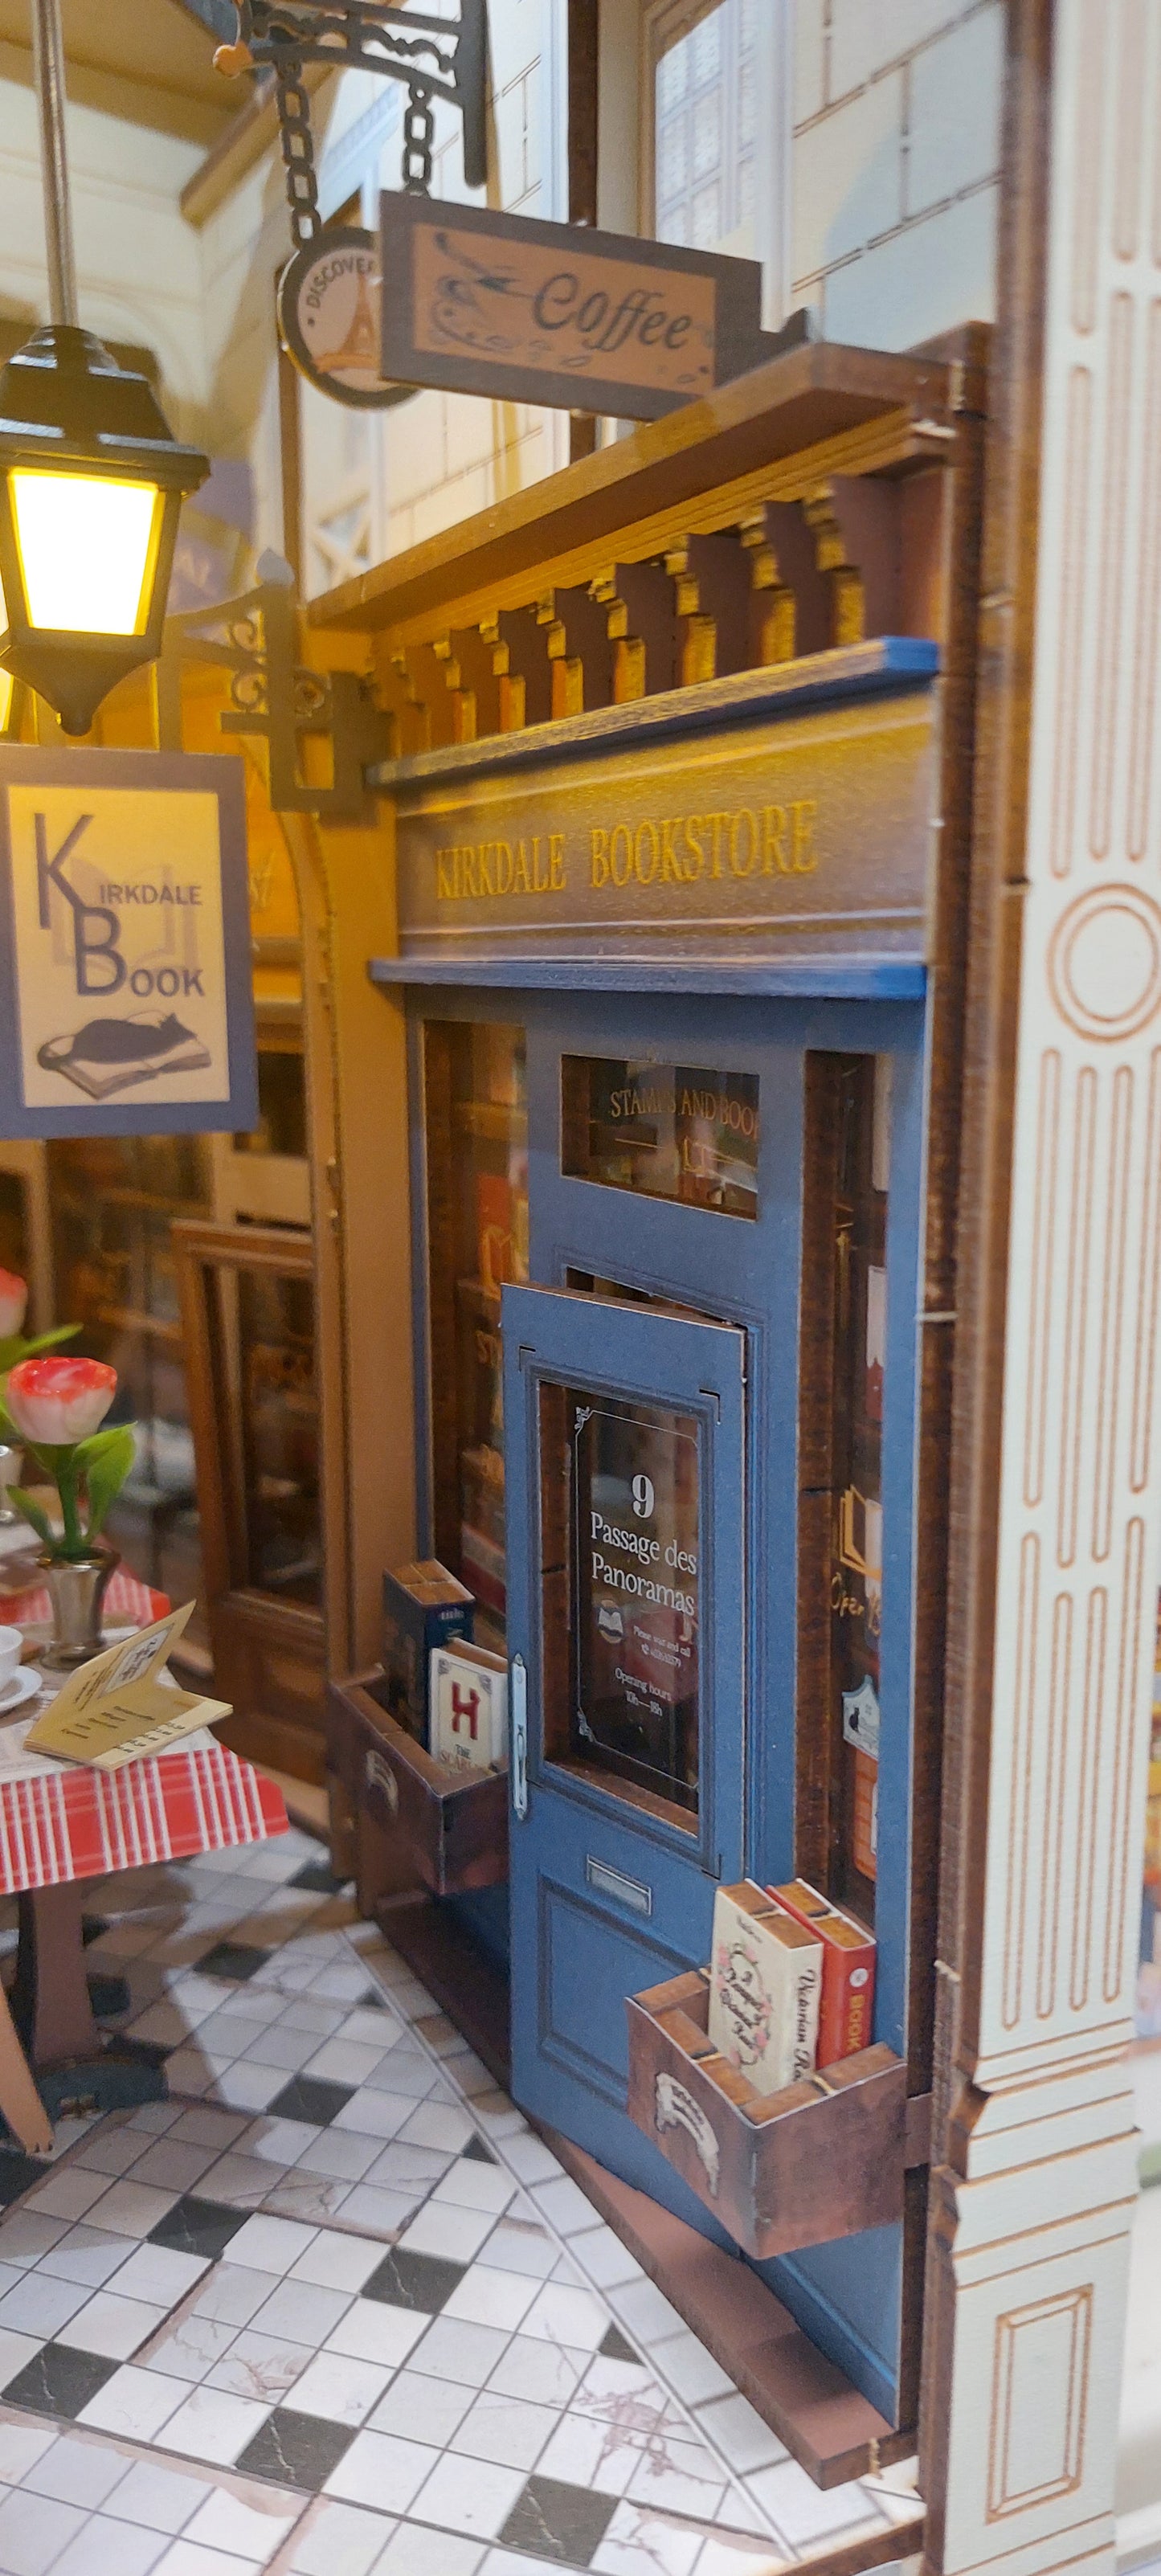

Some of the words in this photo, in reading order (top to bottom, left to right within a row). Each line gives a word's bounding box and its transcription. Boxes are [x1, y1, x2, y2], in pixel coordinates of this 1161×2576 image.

[306, 256, 374, 309] DISCOVE
[533, 272, 693, 352] Coffee
[436, 833, 567, 900] KIRKDALE
[589, 800, 819, 889] BOOKSTORE
[681, 1089, 716, 1120] AND
[632, 1474, 656, 1519] 9
[591, 1511, 660, 1565] Passage
[664, 1539, 697, 1576] des
[591, 1552, 695, 1616] Panoramas
